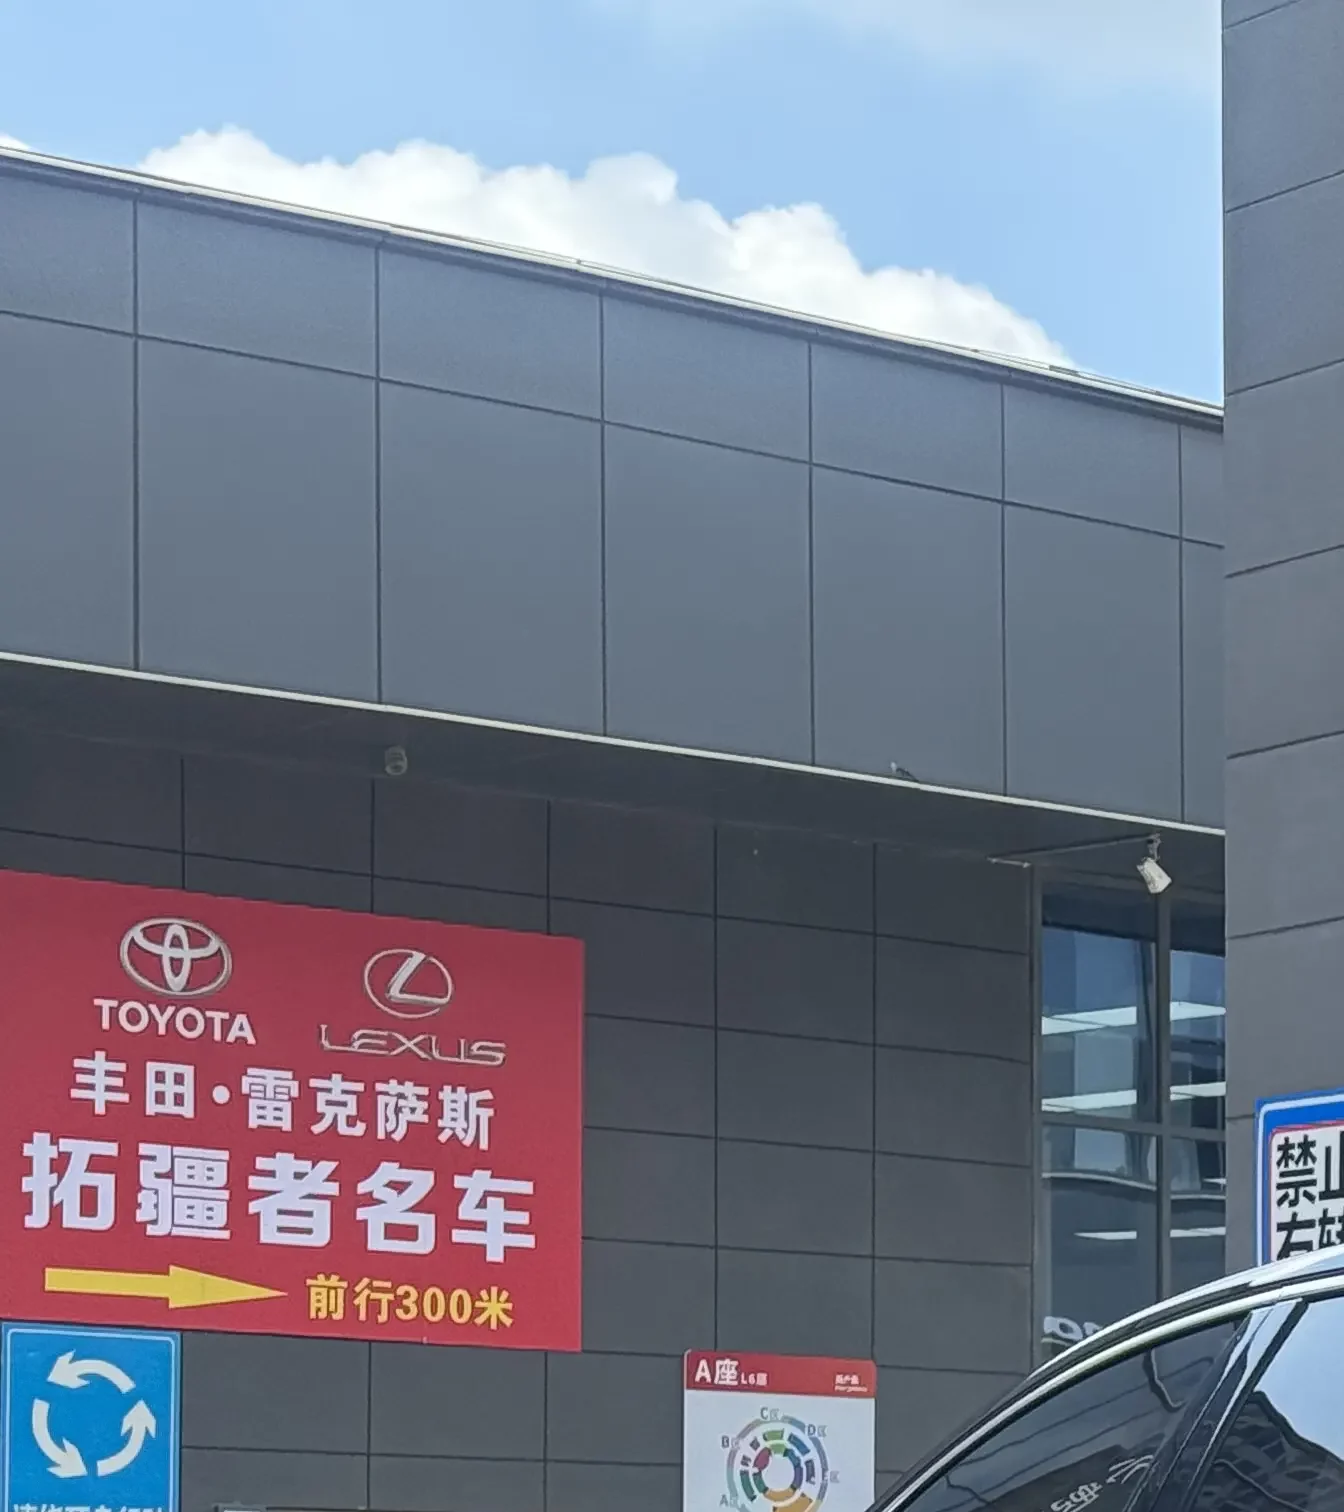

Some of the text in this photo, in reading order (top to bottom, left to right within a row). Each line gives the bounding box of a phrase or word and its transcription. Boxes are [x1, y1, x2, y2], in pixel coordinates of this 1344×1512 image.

[93, 998, 256, 1045] TOYOTA
[320, 1024, 507, 1067] LEXUS
[70, 1050, 496, 1151] 丰田·雷克萨斯
[22, 1131, 537, 1263] 拓疆者名车
[306, 1273, 514, 1331] 前行300米
[694, 1358, 739, 1386] A座
